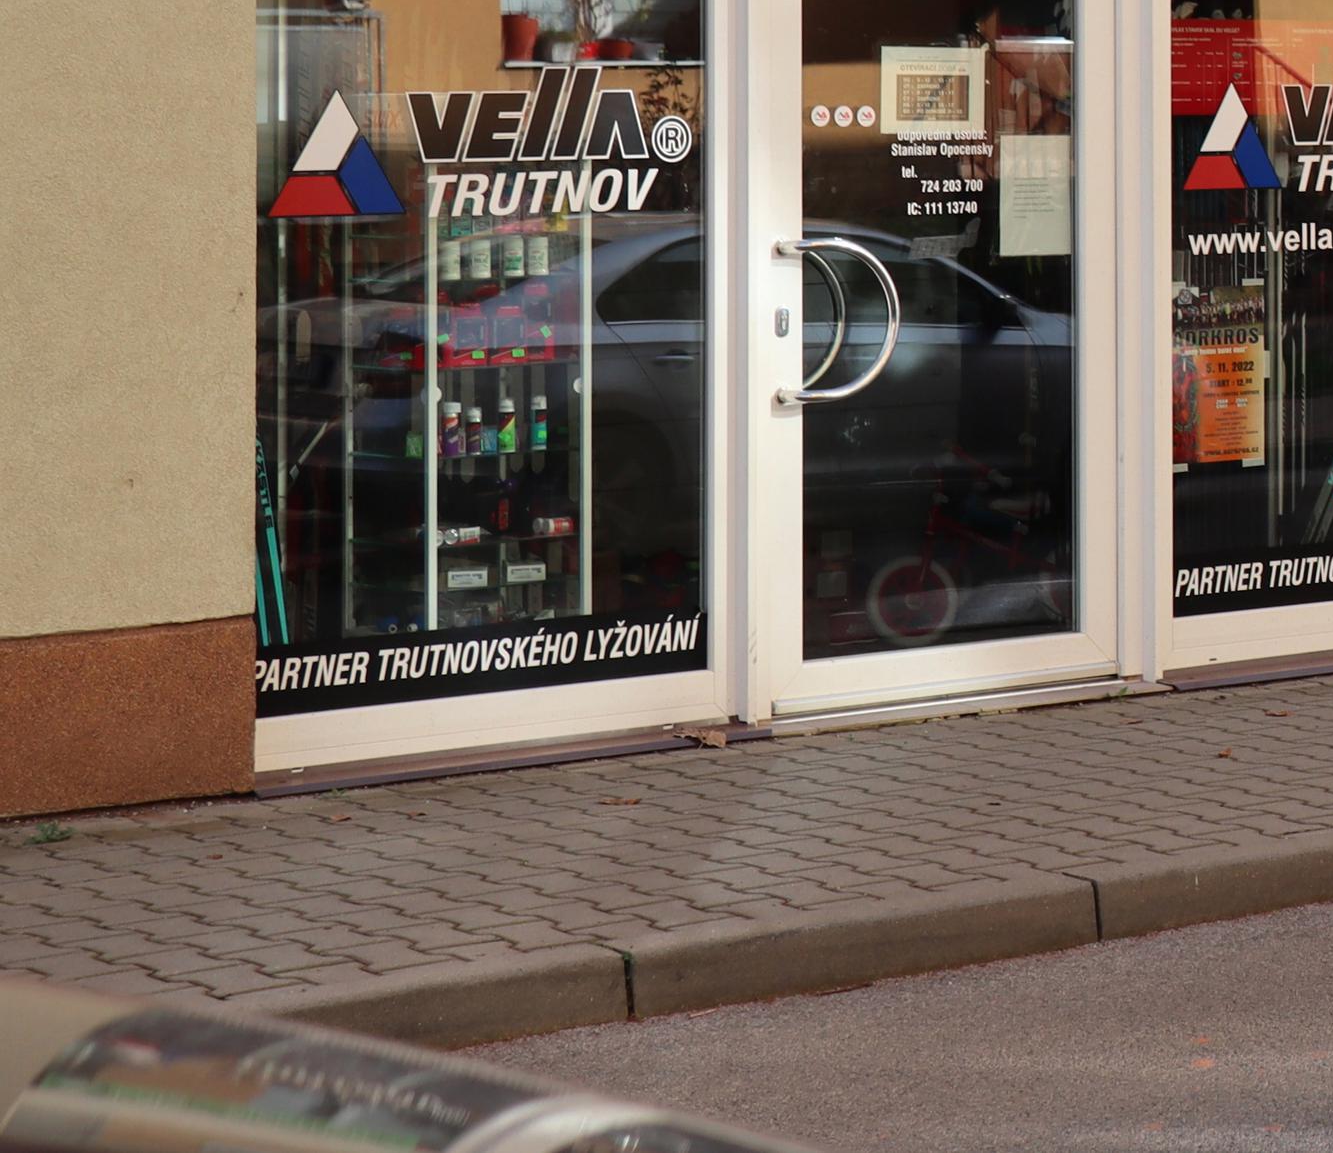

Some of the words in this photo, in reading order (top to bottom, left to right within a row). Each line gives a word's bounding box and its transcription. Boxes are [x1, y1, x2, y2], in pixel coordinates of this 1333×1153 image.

[891, 143, 937, 157] Stanislav
[901, 165, 918, 178] tel.
[427, 168, 659, 217] TRUTNOV
[921, 180, 940, 193] 724
[943, 180, 962, 193] 203
[965, 179, 984, 192] 700
[924, 202, 943, 215] 111
[946, 201, 978, 214] 13740
[1232, 361, 1254, 372] 2022
[1175, 561, 1263, 598] PARTNER
[255, 650, 369, 693] PARTNER
[378, 626, 578, 682] TRUTNOVSKÉHO
[584, 612, 702, 663] LYŽOVÁNÍ
